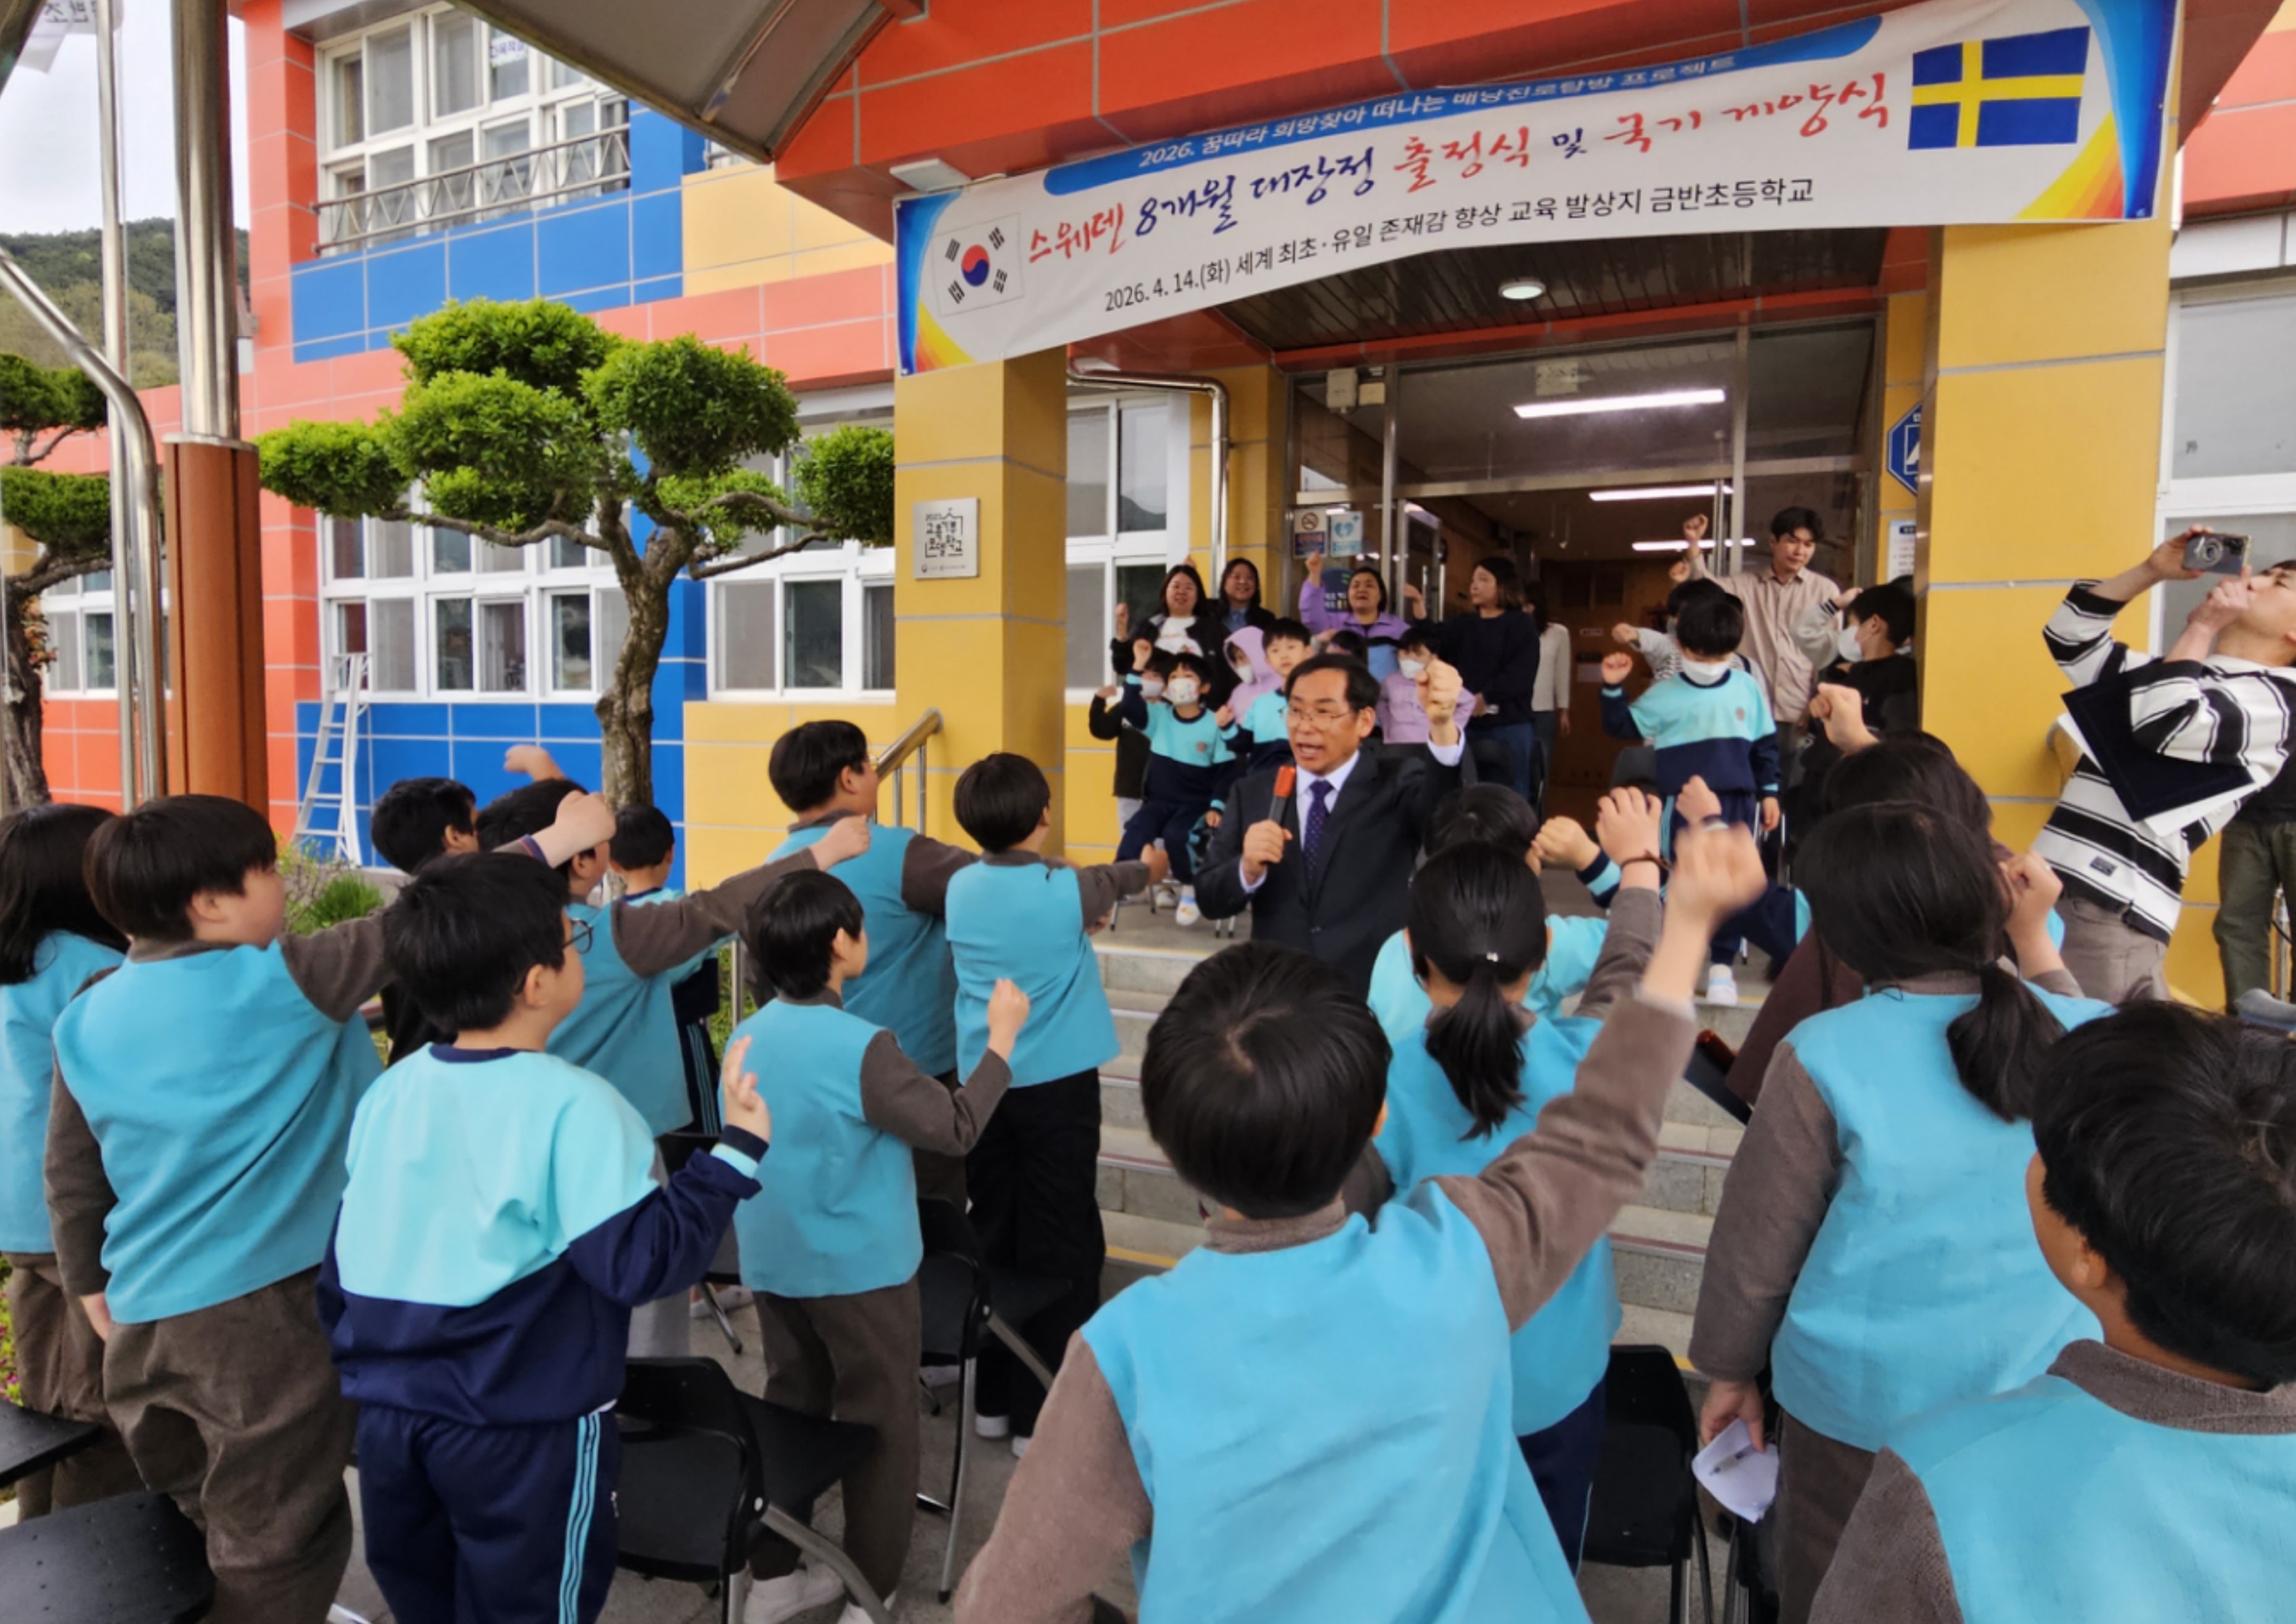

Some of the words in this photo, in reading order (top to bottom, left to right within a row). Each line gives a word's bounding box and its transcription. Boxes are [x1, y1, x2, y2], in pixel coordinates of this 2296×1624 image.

[1029, 202, 1126, 264] 스웨덴
[1135, 174, 1238, 237] 8개월
[1249, 146, 1375, 205] 대장정
[1393, 126, 1530, 194] 출정식
[1551, 128, 1588, 159] 및
[1603, 111, 1702, 154] 국기
[1722, 72, 1889, 137] 게양식
[1138, 142, 1195, 168] 2026.
[1202, 125, 1269, 155] 꿈따라
[1272, 105, 1367, 137] 희망찾아
[1371, 96, 1446, 119] 떠나는
[1452, 75, 1614, 106] 배낭진로탐방
[1620, 55, 1735, 86] 프로젝트
[1105, 283, 1150, 312] 2026.
[1152, 277, 1169, 297] 4.
[1236, 246, 1273, 276] 세계
[1379, 210, 1447, 243] 존재감
[1455, 202, 1503, 229] 향상
[1508, 197, 1558, 221] 교육
[1566, 188, 1642, 219] 발상지
[1649, 178, 1814, 214] 금반초등학교
